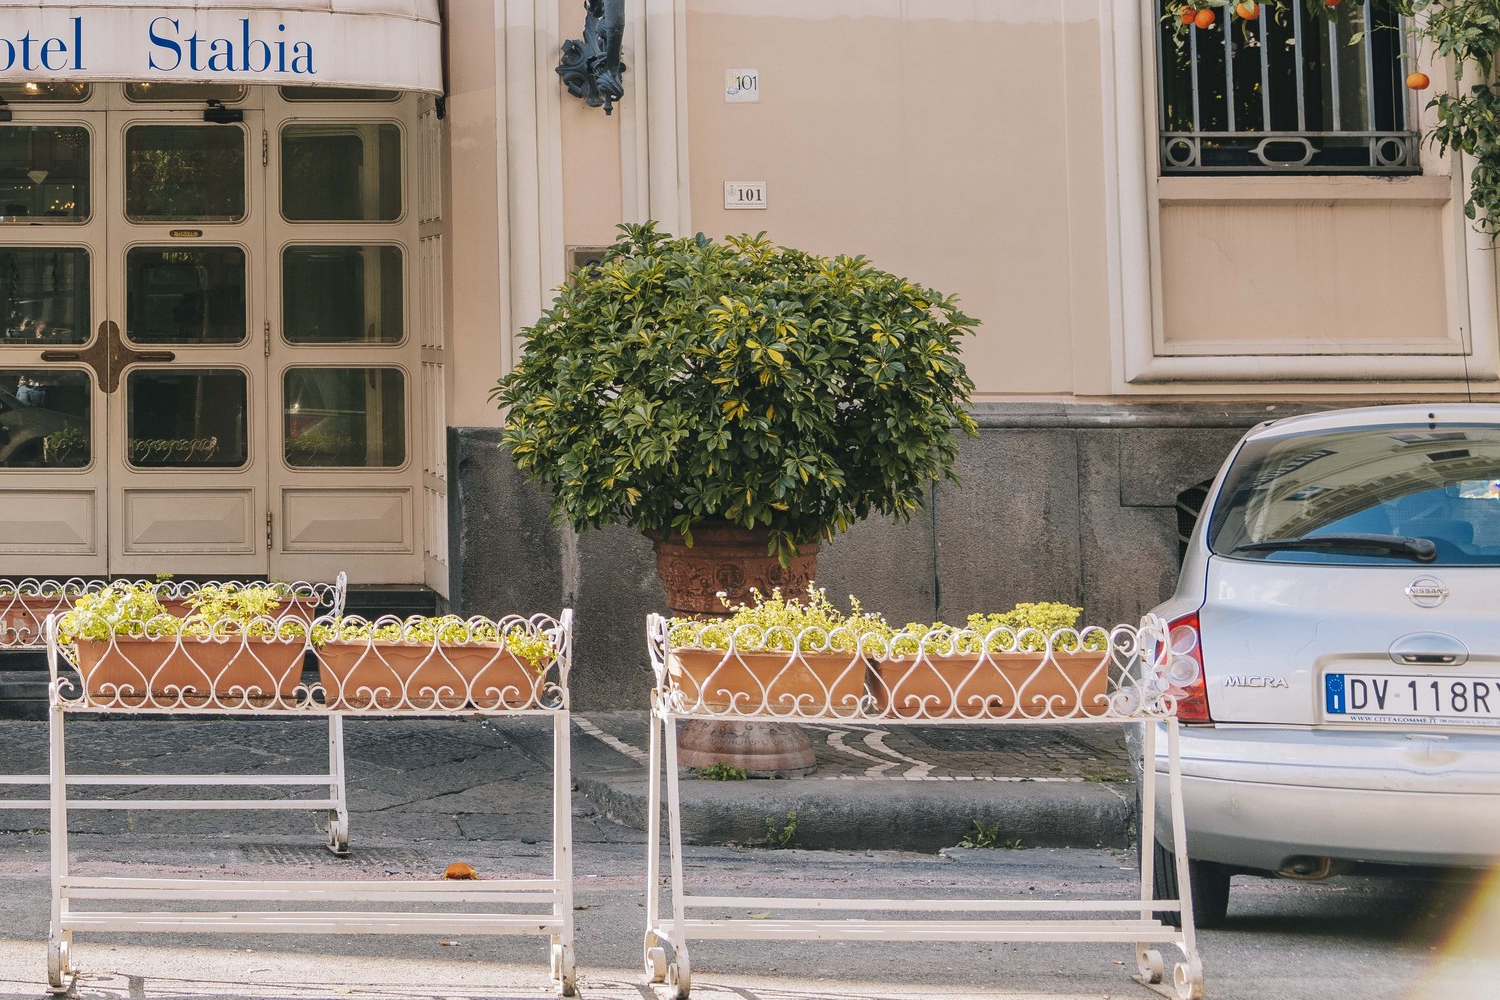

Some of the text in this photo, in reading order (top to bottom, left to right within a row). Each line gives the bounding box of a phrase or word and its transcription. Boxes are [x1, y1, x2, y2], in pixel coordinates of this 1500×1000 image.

[148, 16, 318, 75] Stabia
[736, 74, 757, 91] 101
[737, 188, 763, 202] 101
[1224, 675, 1289, 689] MICRA
[1350, 678, 1389, 711] DV
